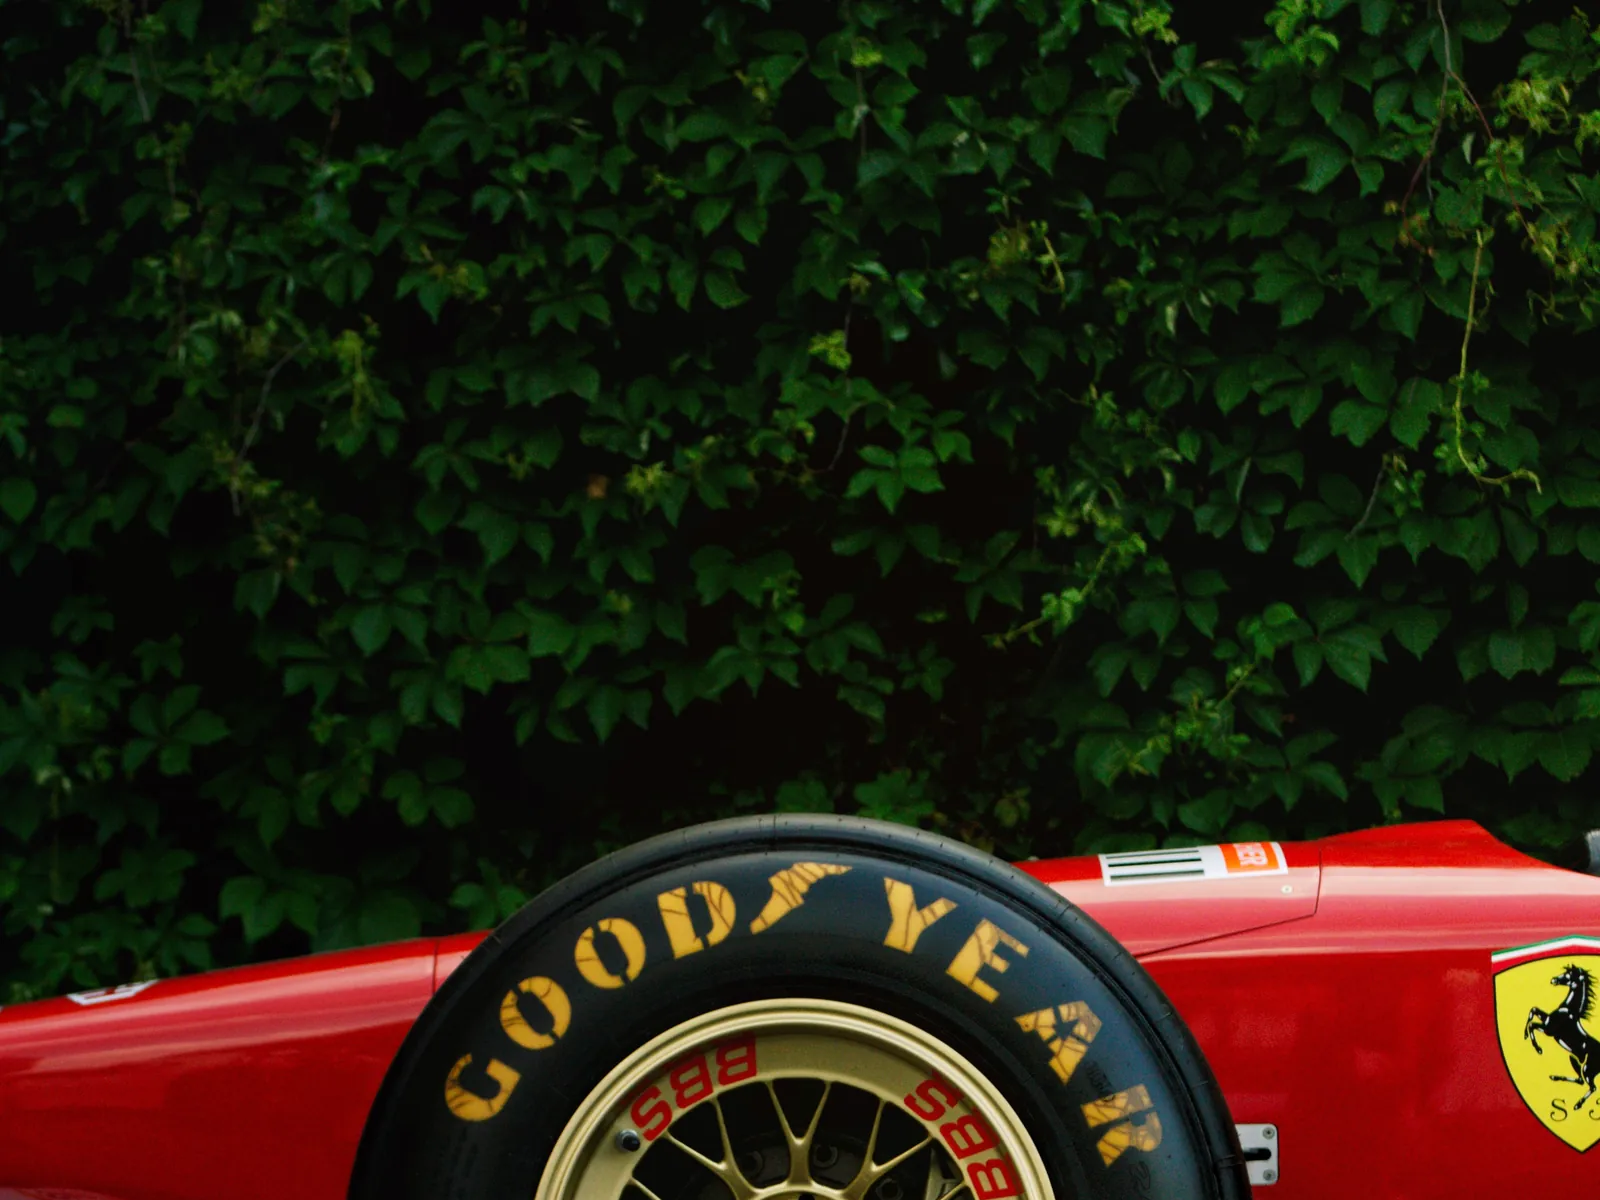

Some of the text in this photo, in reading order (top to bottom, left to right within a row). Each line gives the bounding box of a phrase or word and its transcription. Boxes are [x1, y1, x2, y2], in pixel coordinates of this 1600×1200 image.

[628, 1034, 757, 1141] BBS
[904, 1072, 1022, 1200] BBS
[1549, 1098, 1568, 1122] S
